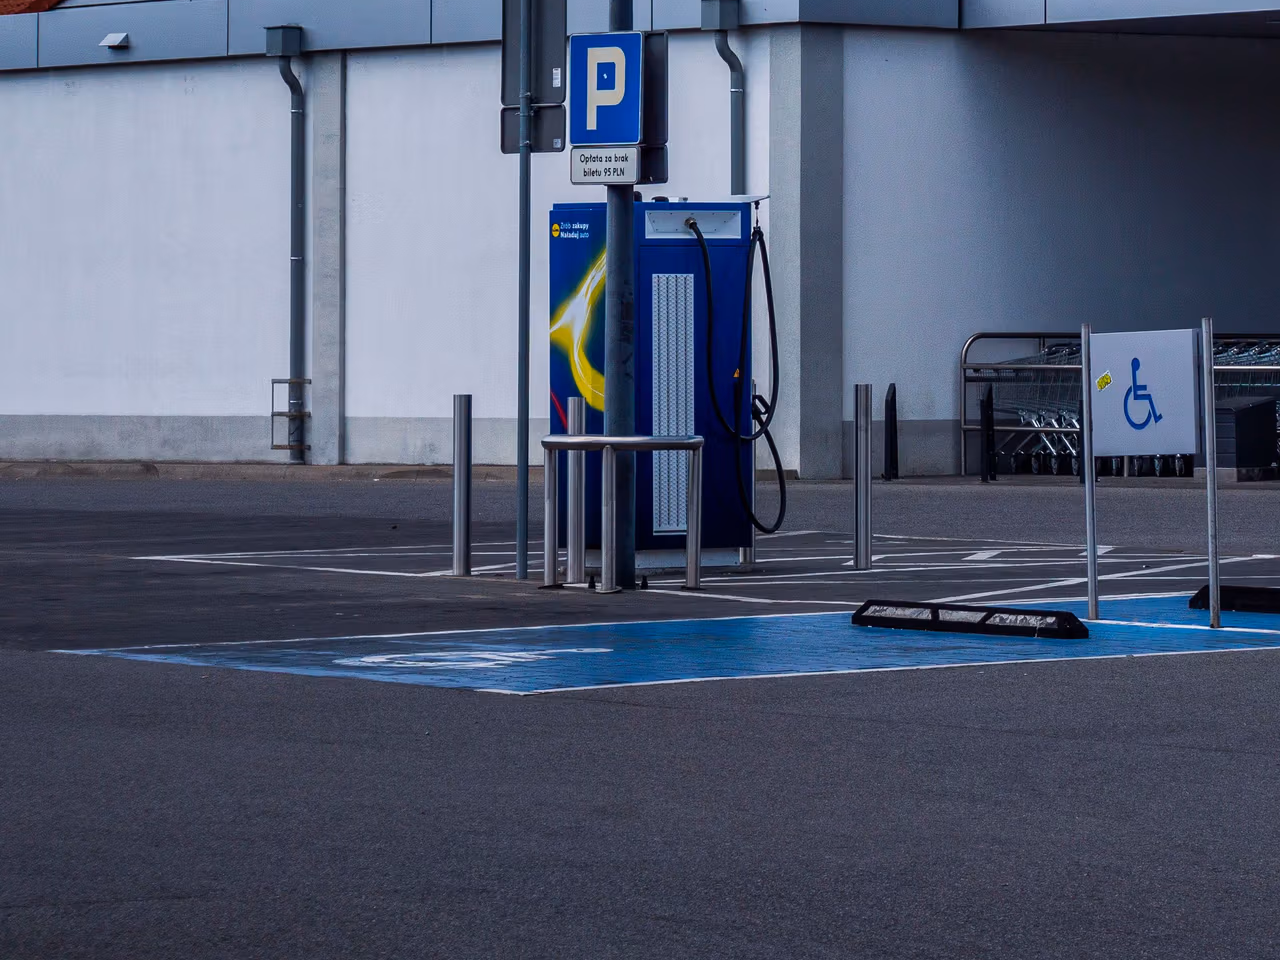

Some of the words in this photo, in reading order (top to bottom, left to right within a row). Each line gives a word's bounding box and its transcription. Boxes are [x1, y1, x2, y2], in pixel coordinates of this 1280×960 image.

[586, 46, 626, 130] P
[580, 154, 603, 165] Opłata
[605, 155, 612, 163] za
[615, 153, 628, 162] brak
[583, 168, 602, 178] biletu
[604, 168, 612, 177] 95
[613, 167, 625, 176] PLN
[572, 222, 590, 231] zakupy
[560, 231, 579, 240] Naładuj
